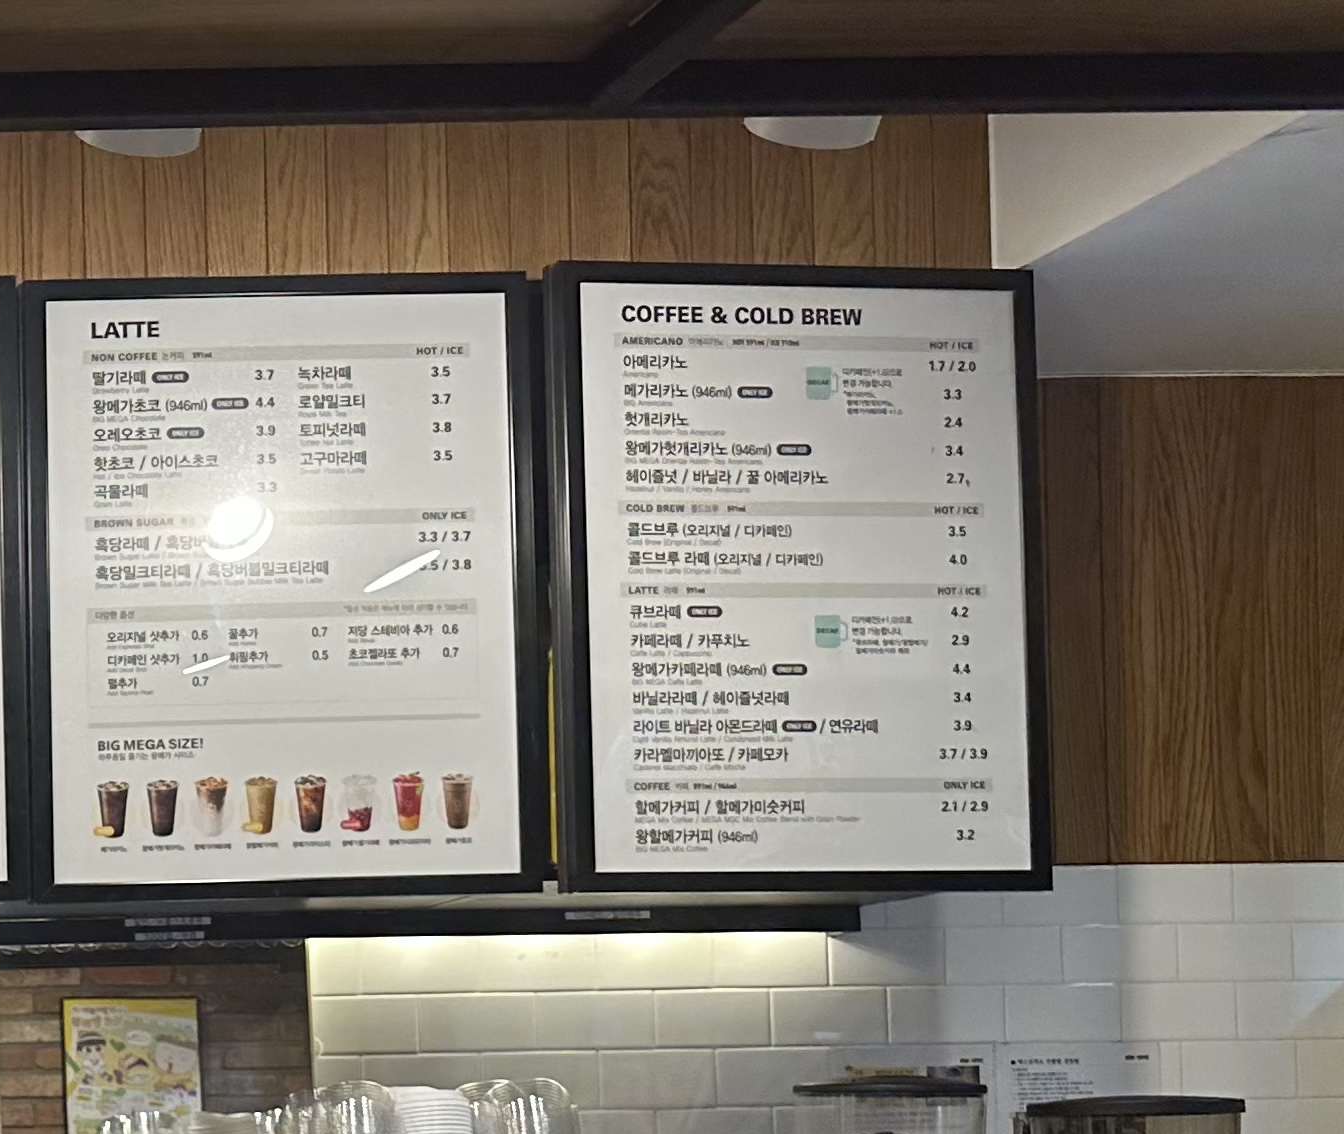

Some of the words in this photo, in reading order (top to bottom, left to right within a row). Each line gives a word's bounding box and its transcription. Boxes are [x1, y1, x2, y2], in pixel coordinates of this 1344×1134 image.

[622, 305, 703, 323] COFFEE
[711, 307, 727, 323] &
[735, 307, 793, 324] COLD
[802, 309, 862, 325] BREW
[92, 321, 159, 339] LATTE
[622, 337, 683, 346] AMERICANO
[624, 355, 688, 369] 아메리카노
[93, 370, 146, 386] 딸기라떼
[255, 370, 274, 380] 3.7
[298, 366, 351, 381] 녹차라떼
[431, 366, 450, 377] 3.5
[625, 383, 688, 398] 메가리카노
[692, 386, 732, 399] (946ml)
[944, 389, 962, 400] 3.3
[93, 399, 161, 414] 왕메가초코
[166, 399, 207, 412] (946ml)
[256, 397, 275, 407] 4.4
[299, 394, 365, 409] 로얄밀크티
[432, 394, 451, 404] 3.7
[625, 412, 689, 427] 헛개리카노
[945, 417, 962, 428] 2.4
[93, 427, 161, 442] 오레오초코
[256, 425, 275, 436] 3.9
[299, 422, 366, 437] 토피넛라떼
[433, 422, 452, 433] 3.8
[301, 451, 367, 466] 고구마라떼
[434, 450, 452, 461] 3.5
[94, 484, 148, 499] 곡물라떼
[630, 605, 681, 619] 큐브라떼
[951, 607, 968, 618] 4.2
[632, 662, 722, 677] 왕메가카페라떼
[727, 664, 767, 677] (946ml)
[953, 664, 970, 674] 4.4
[98, 740, 120, 751] BIG
[124, 739, 165, 750] MEGA
[169, 738, 203, 749] SIZE!
